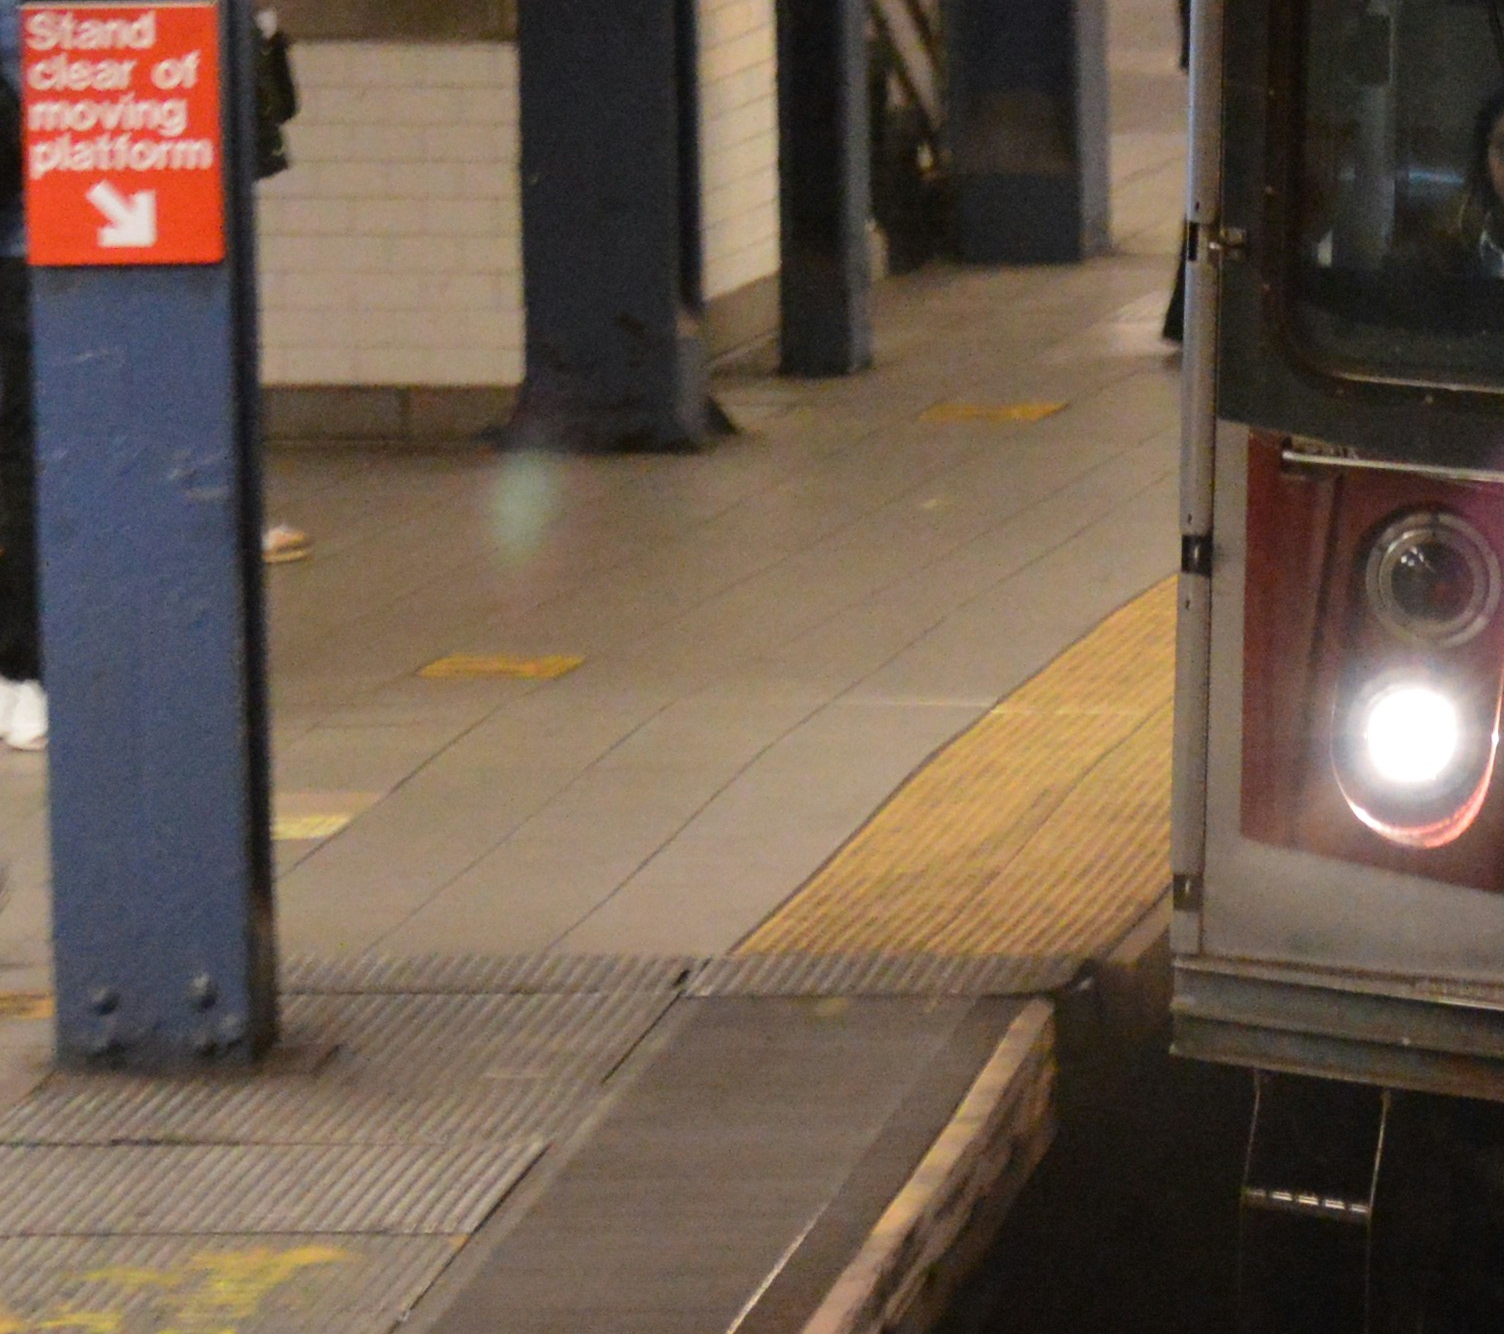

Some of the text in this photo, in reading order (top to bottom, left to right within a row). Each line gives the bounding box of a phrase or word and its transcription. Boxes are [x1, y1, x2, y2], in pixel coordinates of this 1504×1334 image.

[26, 10, 156, 51] Stand
[27, 49, 200, 91] clear of
[27, 91, 187, 137] moving
[29, 132, 213, 180] platform
